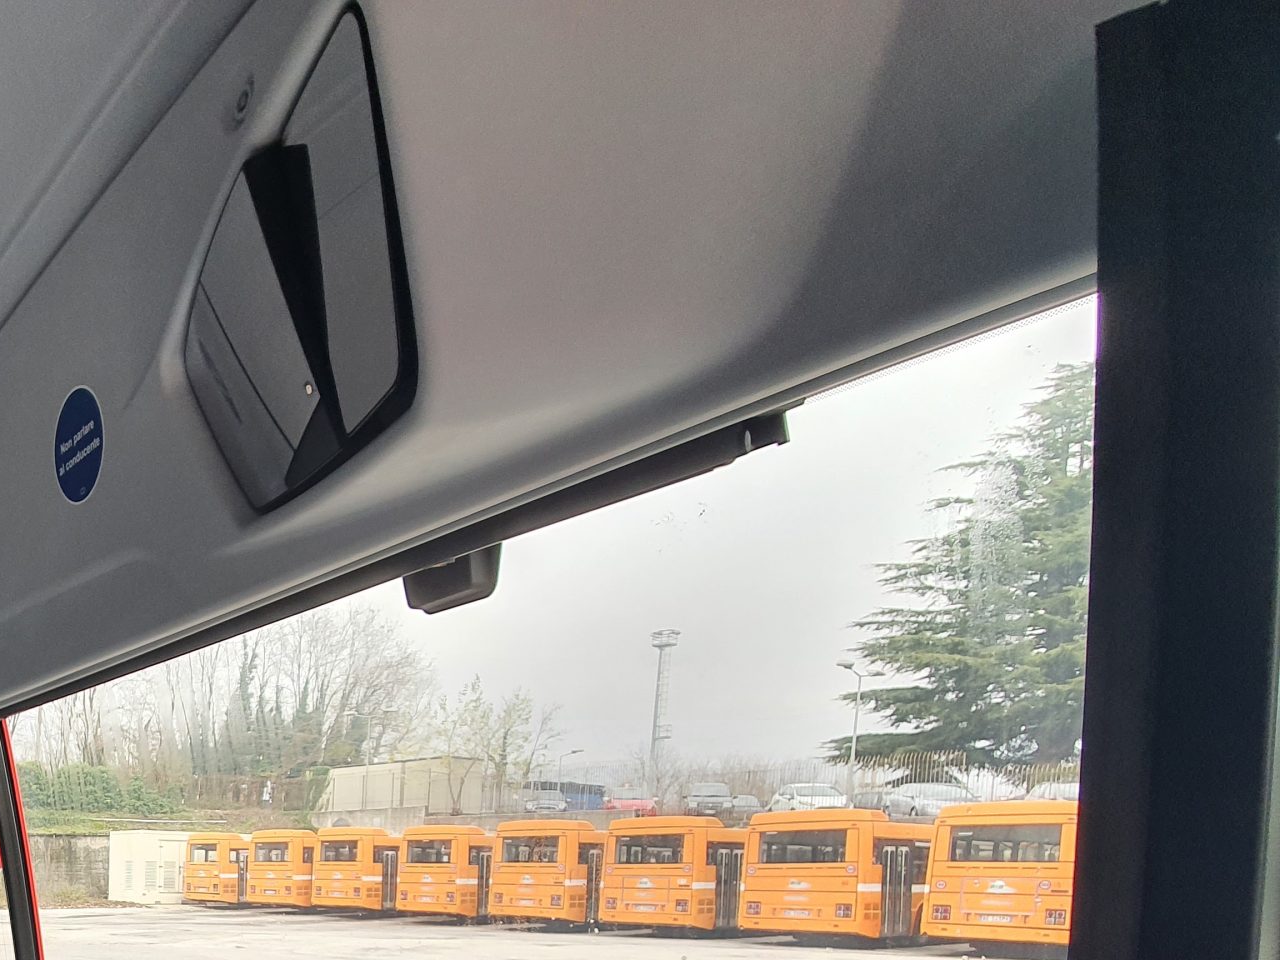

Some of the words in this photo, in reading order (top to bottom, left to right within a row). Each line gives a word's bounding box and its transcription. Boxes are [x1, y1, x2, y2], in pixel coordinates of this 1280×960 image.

[60, 439, 73, 455] Non
[73, 420, 94, 447] parlare
[65, 437, 100, 471] conducente
